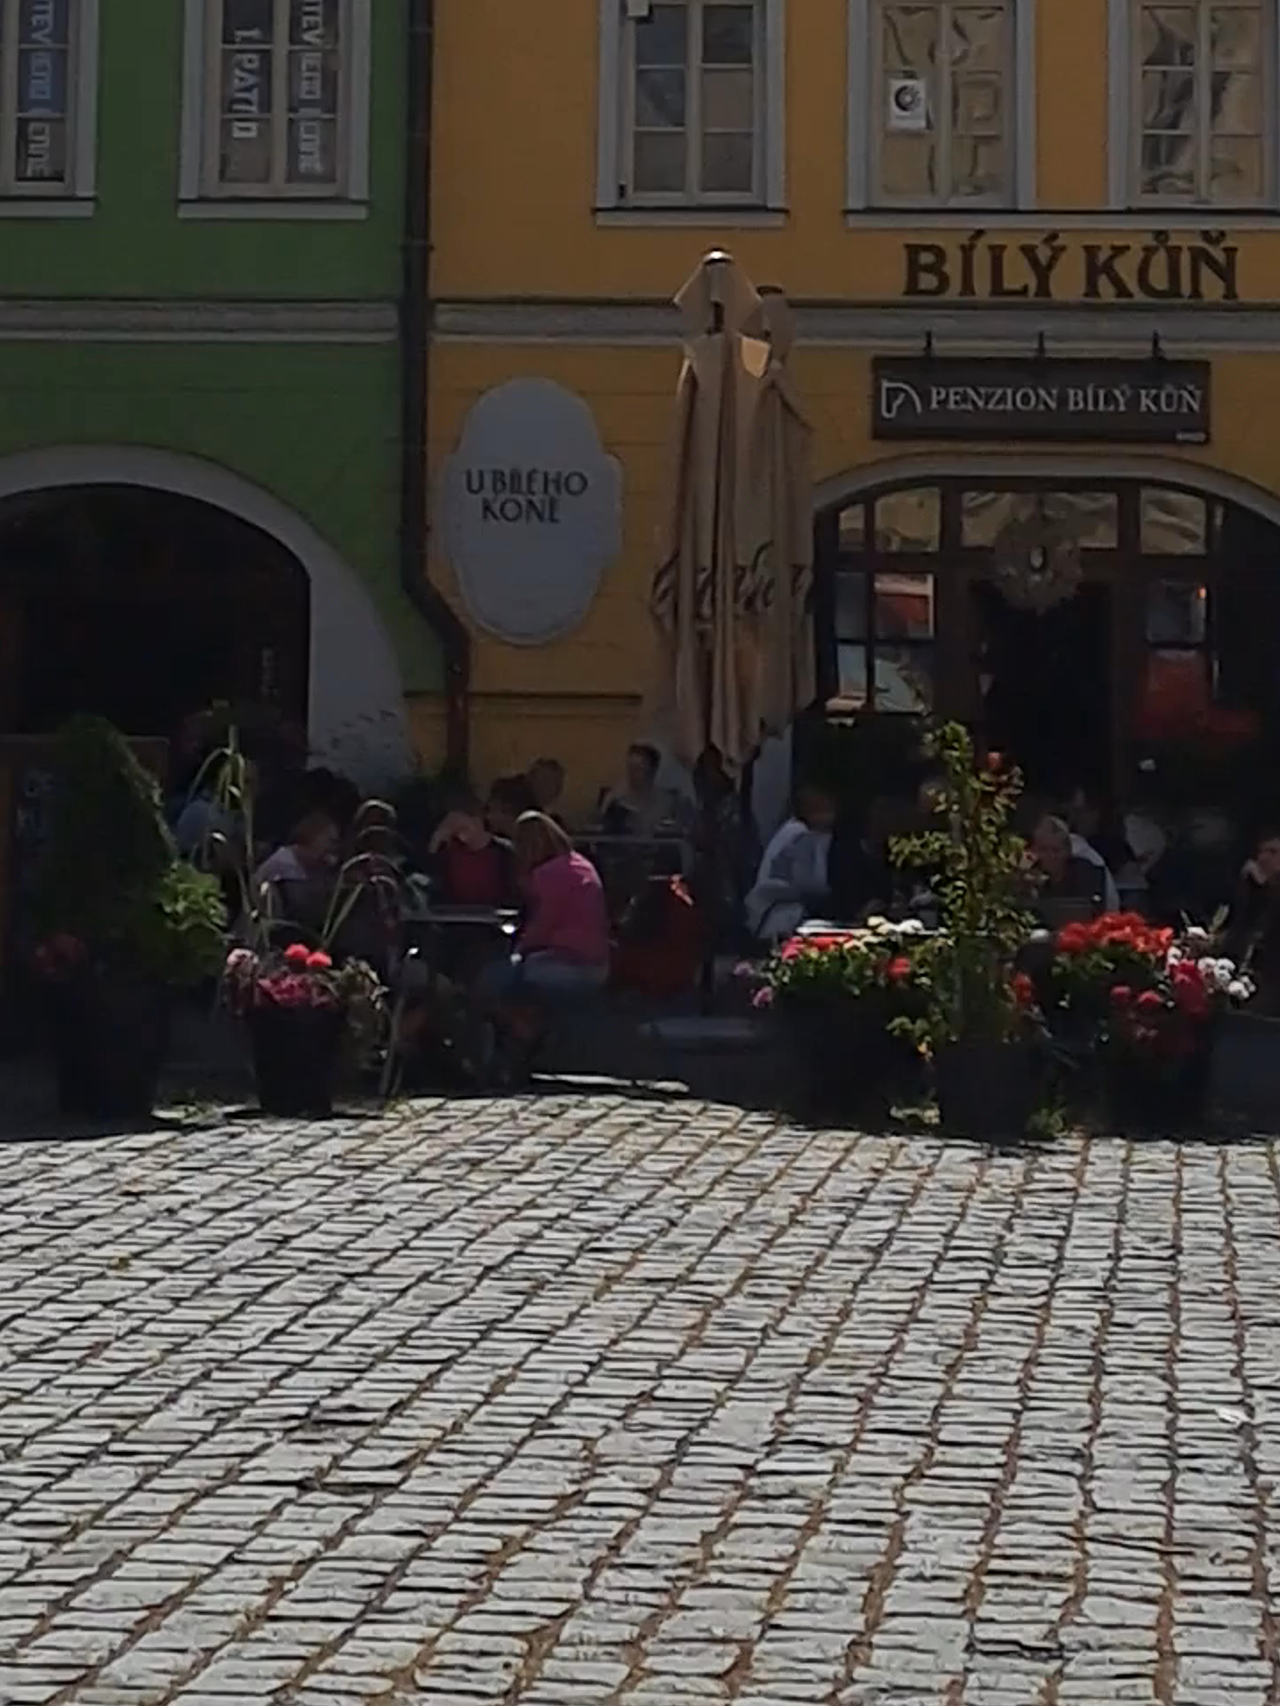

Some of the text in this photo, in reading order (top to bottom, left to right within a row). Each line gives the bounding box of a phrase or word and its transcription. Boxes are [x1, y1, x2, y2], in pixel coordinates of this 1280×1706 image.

[903, 229, 1239, 300] BÍLÝ KŮŇ
[929, 383, 1203, 415] PENZION BÍLÝ KŮŇ
[465, 468, 485, 496] U
